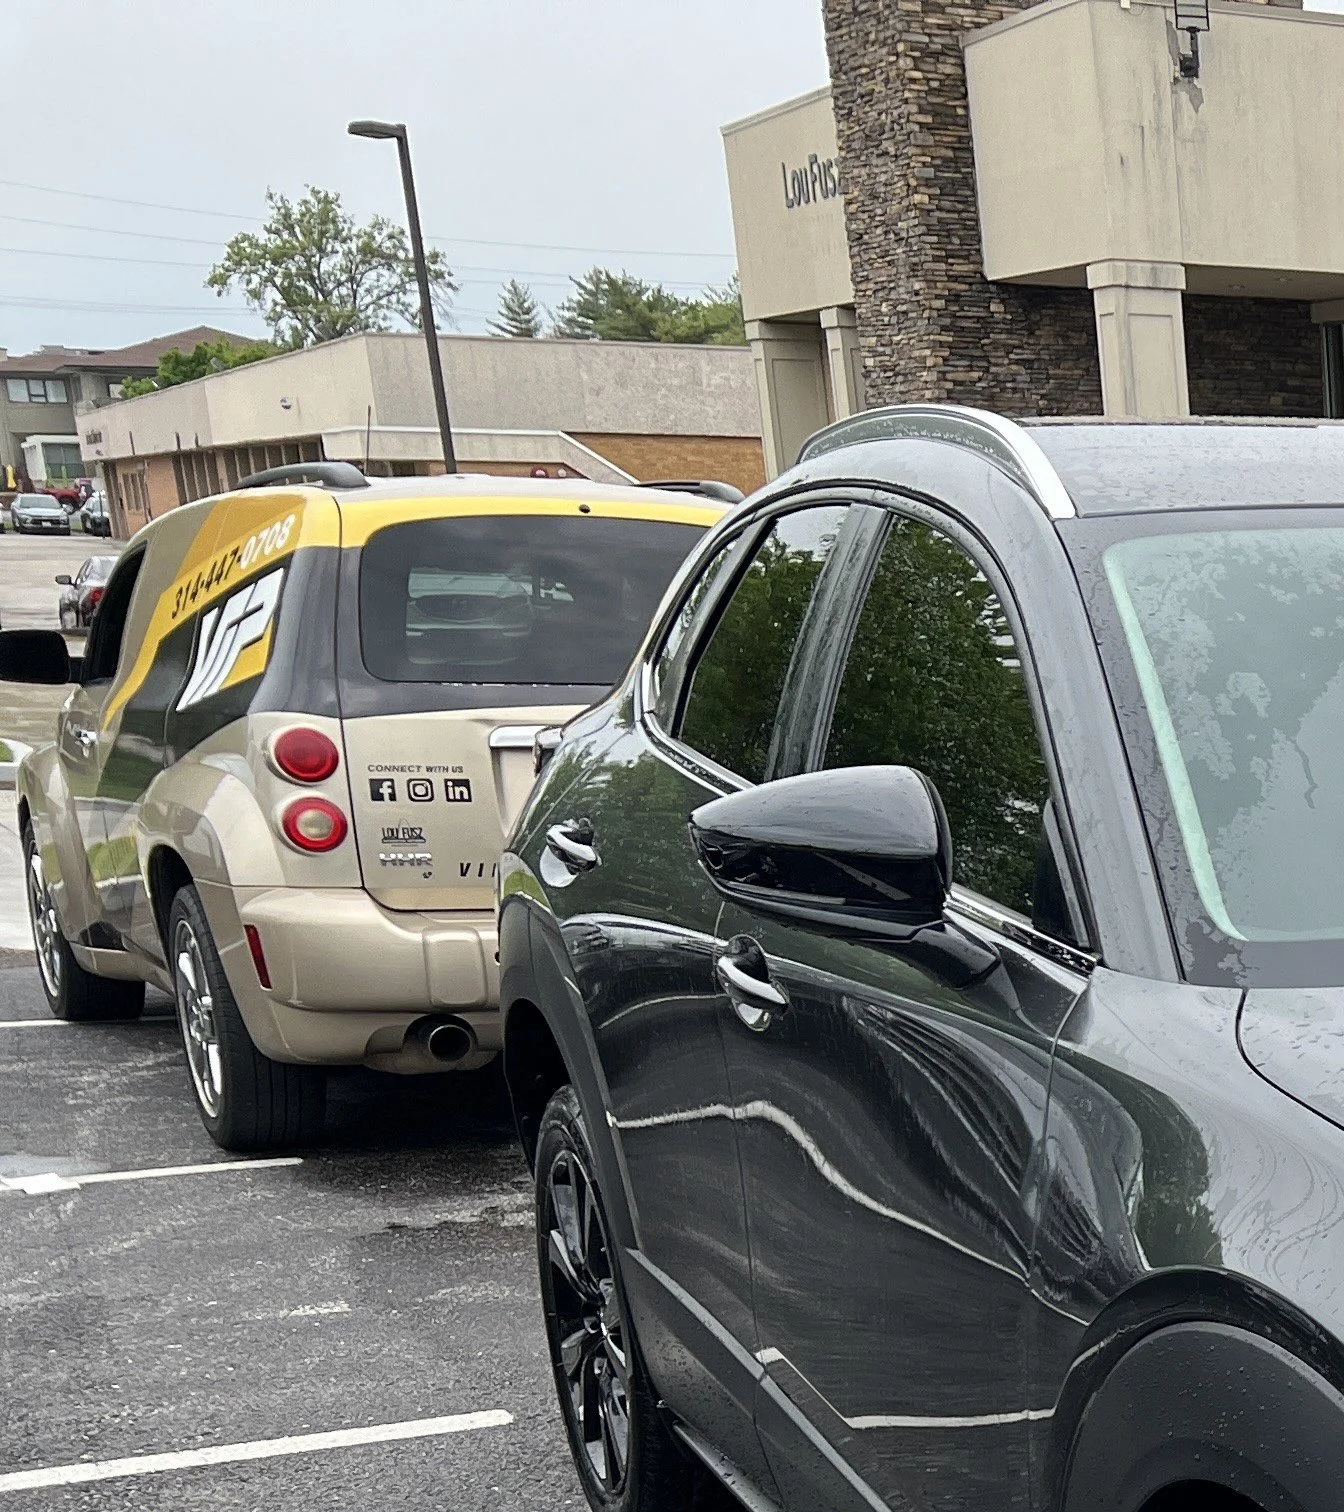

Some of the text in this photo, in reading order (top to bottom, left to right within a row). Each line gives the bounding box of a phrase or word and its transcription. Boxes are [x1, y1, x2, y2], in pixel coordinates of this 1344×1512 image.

[367, 764, 464, 774] CONNECT WITH US
[379, 852, 433, 867] HHR
